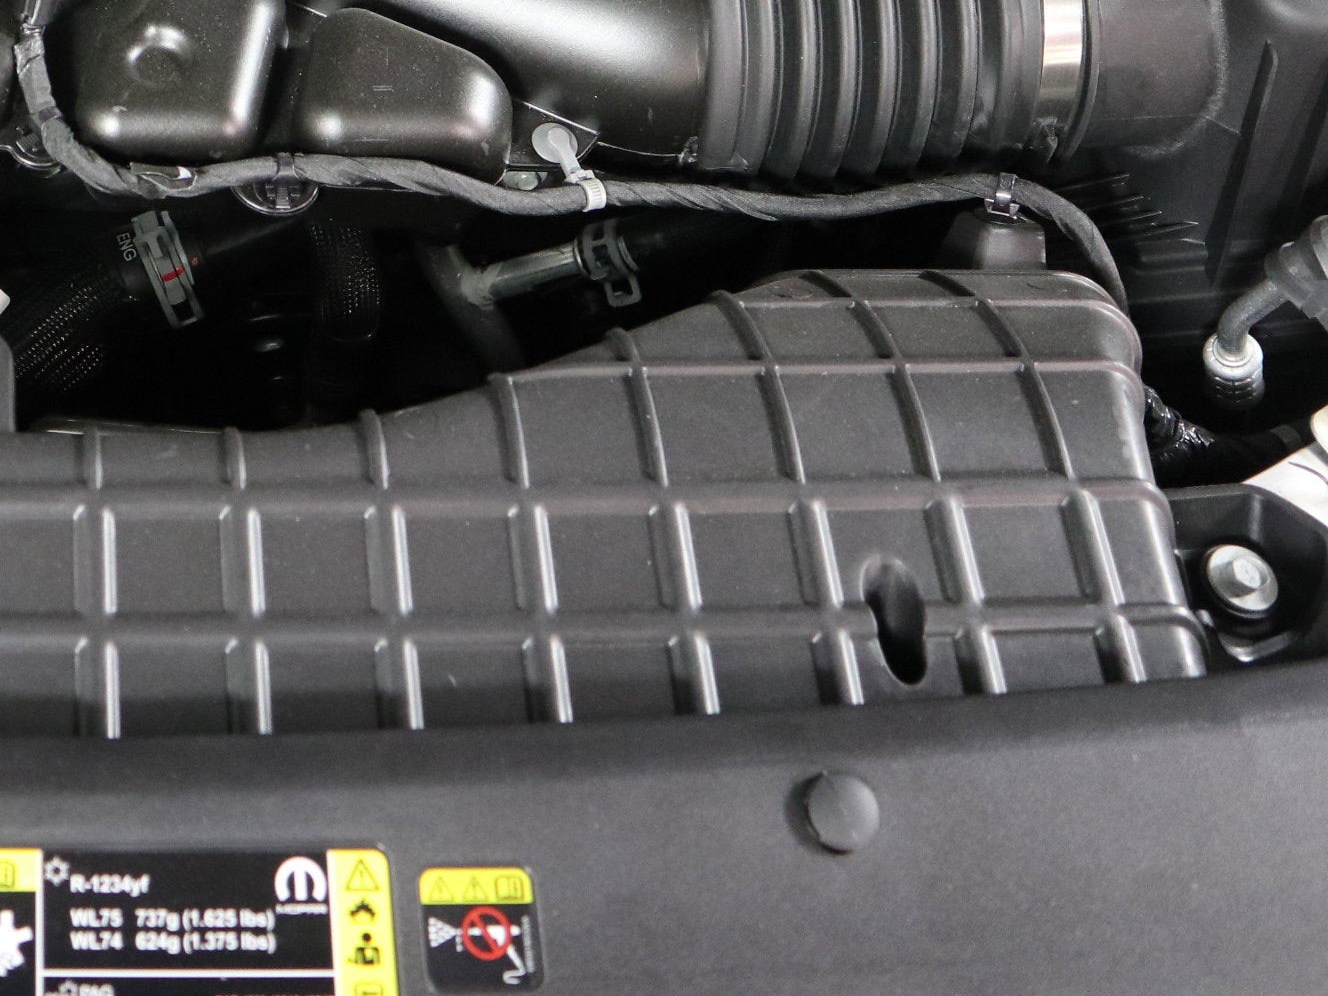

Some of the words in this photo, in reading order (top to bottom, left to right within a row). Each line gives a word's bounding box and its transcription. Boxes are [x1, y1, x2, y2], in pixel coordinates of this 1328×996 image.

[116, 232, 137, 262] ENG
[70, 874, 150, 897] R-1234yf
[70, 908, 123, 928] WL75
[135, 908, 180, 932] 737g
[182, 908, 238, 932] (1.625
[239, 908, 275, 932] lbs)
[70, 931, 123, 951] WL74
[135, 931, 181, 955] 624g
[182, 931, 238, 955] (1.375
[240, 931, 277, 955] lbs)
